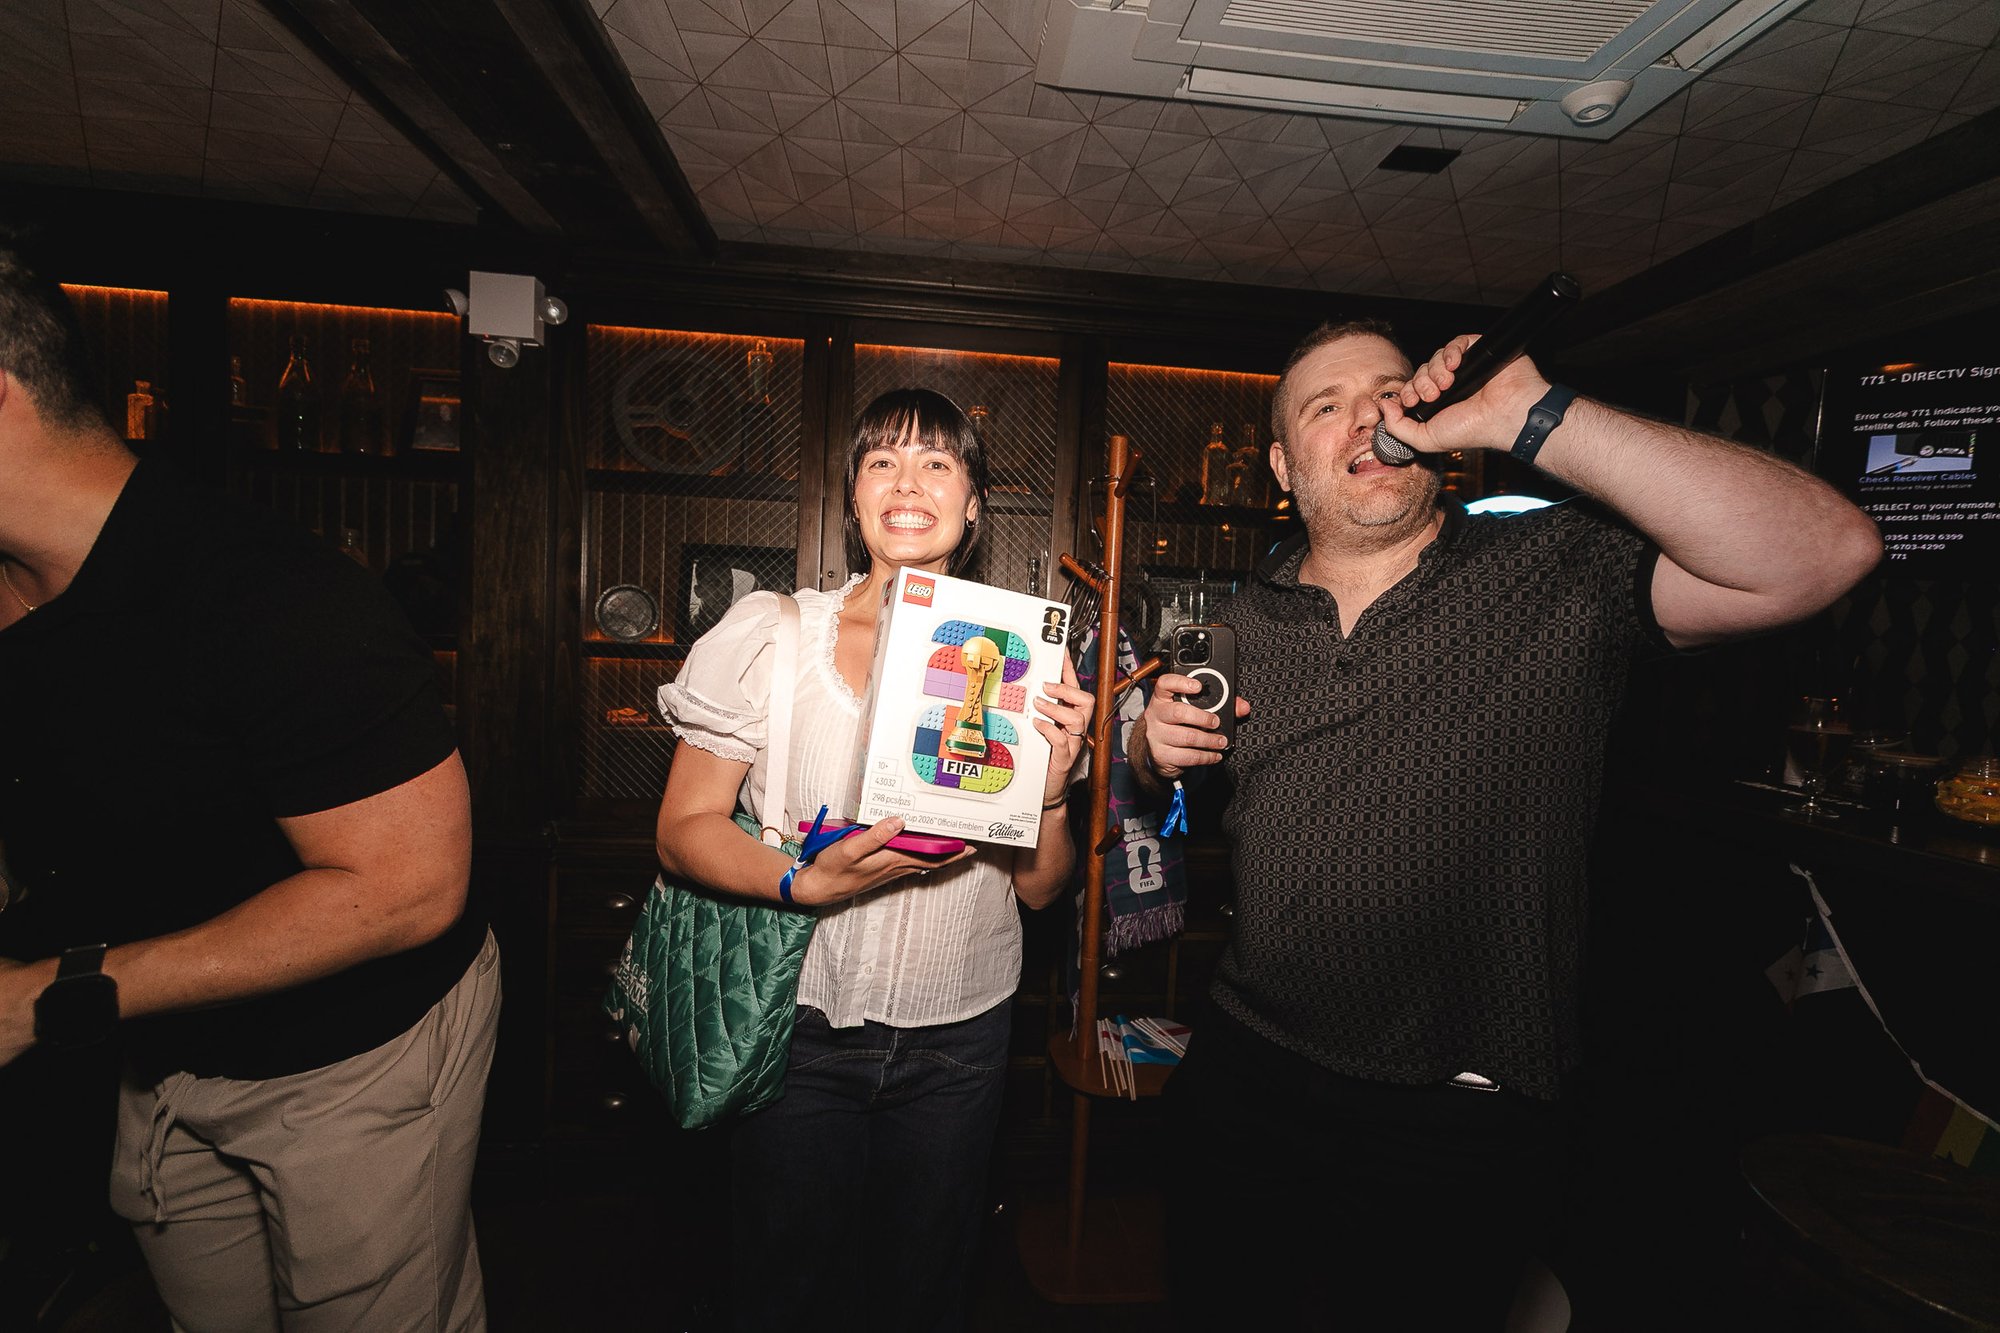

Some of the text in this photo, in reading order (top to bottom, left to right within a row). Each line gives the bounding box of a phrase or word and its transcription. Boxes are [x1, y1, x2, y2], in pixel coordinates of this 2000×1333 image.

[1860, 375, 1886, 386] 771
[1901, 368, 1967, 383] DIRECTV
[1855, 413, 1880, 421] Error
[1882, 411, 1909, 419] code
[1911, 409, 1930, 417] 771
[1933, 406, 1983, 416] indicates
[1853, 422, 1894, 432] satellite
[1896, 421, 1921, 429] dish.
[1924, 419, 1961, 427] Follow
[1962, 417, 1994, 425] these
[1893, 474, 1937, 482] Receiver
[1872, 503, 1911, 511] SELECT
[1929, 503, 1954, 512] your
[1921, 513, 1941, 521] this
[1943, 512, 1965, 520] info
[905, 581, 933, 599] LEGO
[877, 761, 888, 770] 10+
[946, 761, 979, 777] FIFA
[875, 777, 897, 787] 43032
[872, 792, 911, 807] 298 pcs/pzs
[869, 808, 884, 817] FIFA
[904, 813, 918, 823] Cup
[937, 818, 958, 829] Official
[958, 820, 984, 832] Emblem
[988, 822, 1024, 839] Editions
[1139, 880, 1155, 889] FIFA
